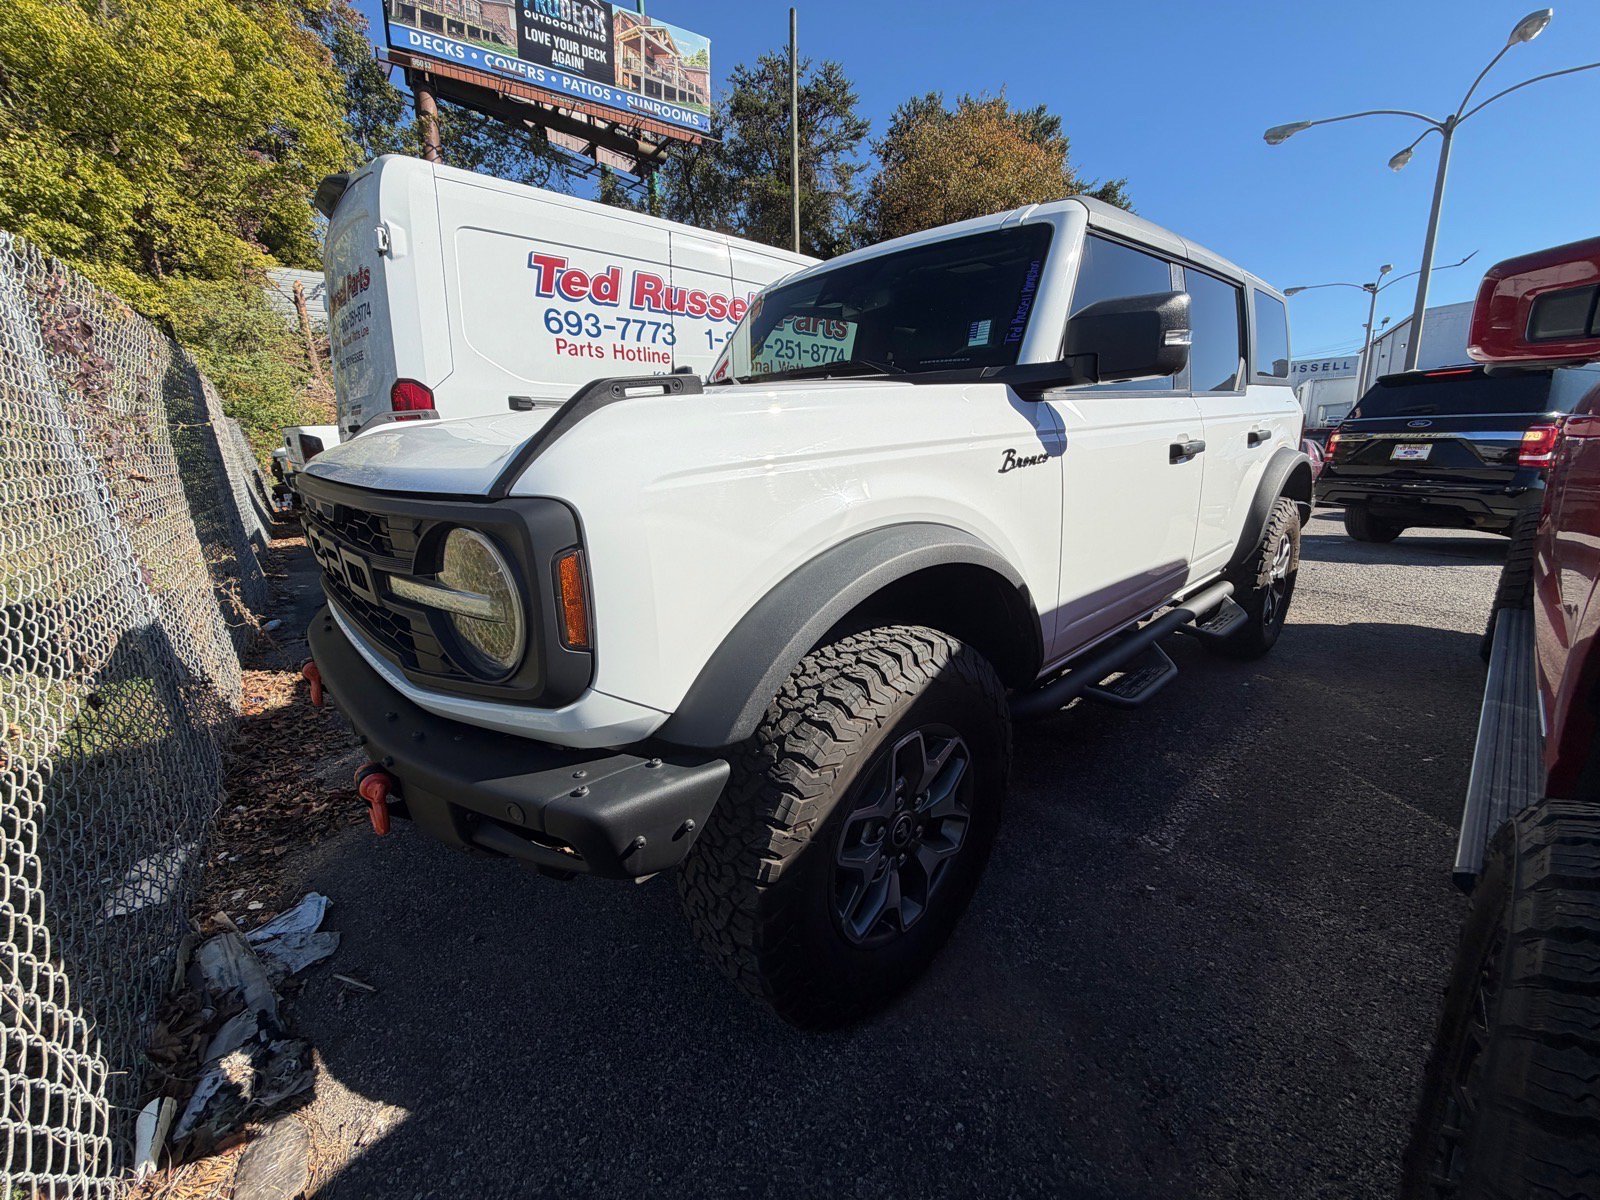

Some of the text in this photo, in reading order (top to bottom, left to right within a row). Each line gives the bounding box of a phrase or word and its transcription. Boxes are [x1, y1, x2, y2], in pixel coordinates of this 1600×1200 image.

[524, 26, 607, 64] LOVE YOUR DECK
[551, 49, 585, 71] AGAIN!
[409, 31, 465, 59] DECKS
[484, 54, 546, 82] COVERS
[562, 76, 611, 101] PATIOS
[626, 95, 700, 126] SUNROOMS
[527, 250, 764, 328] Ted Russe
[543, 307, 677, 347] 693-7773
[555, 337, 671, 364] Parts Hotline
[997, 448, 1050, 474] Bronco
